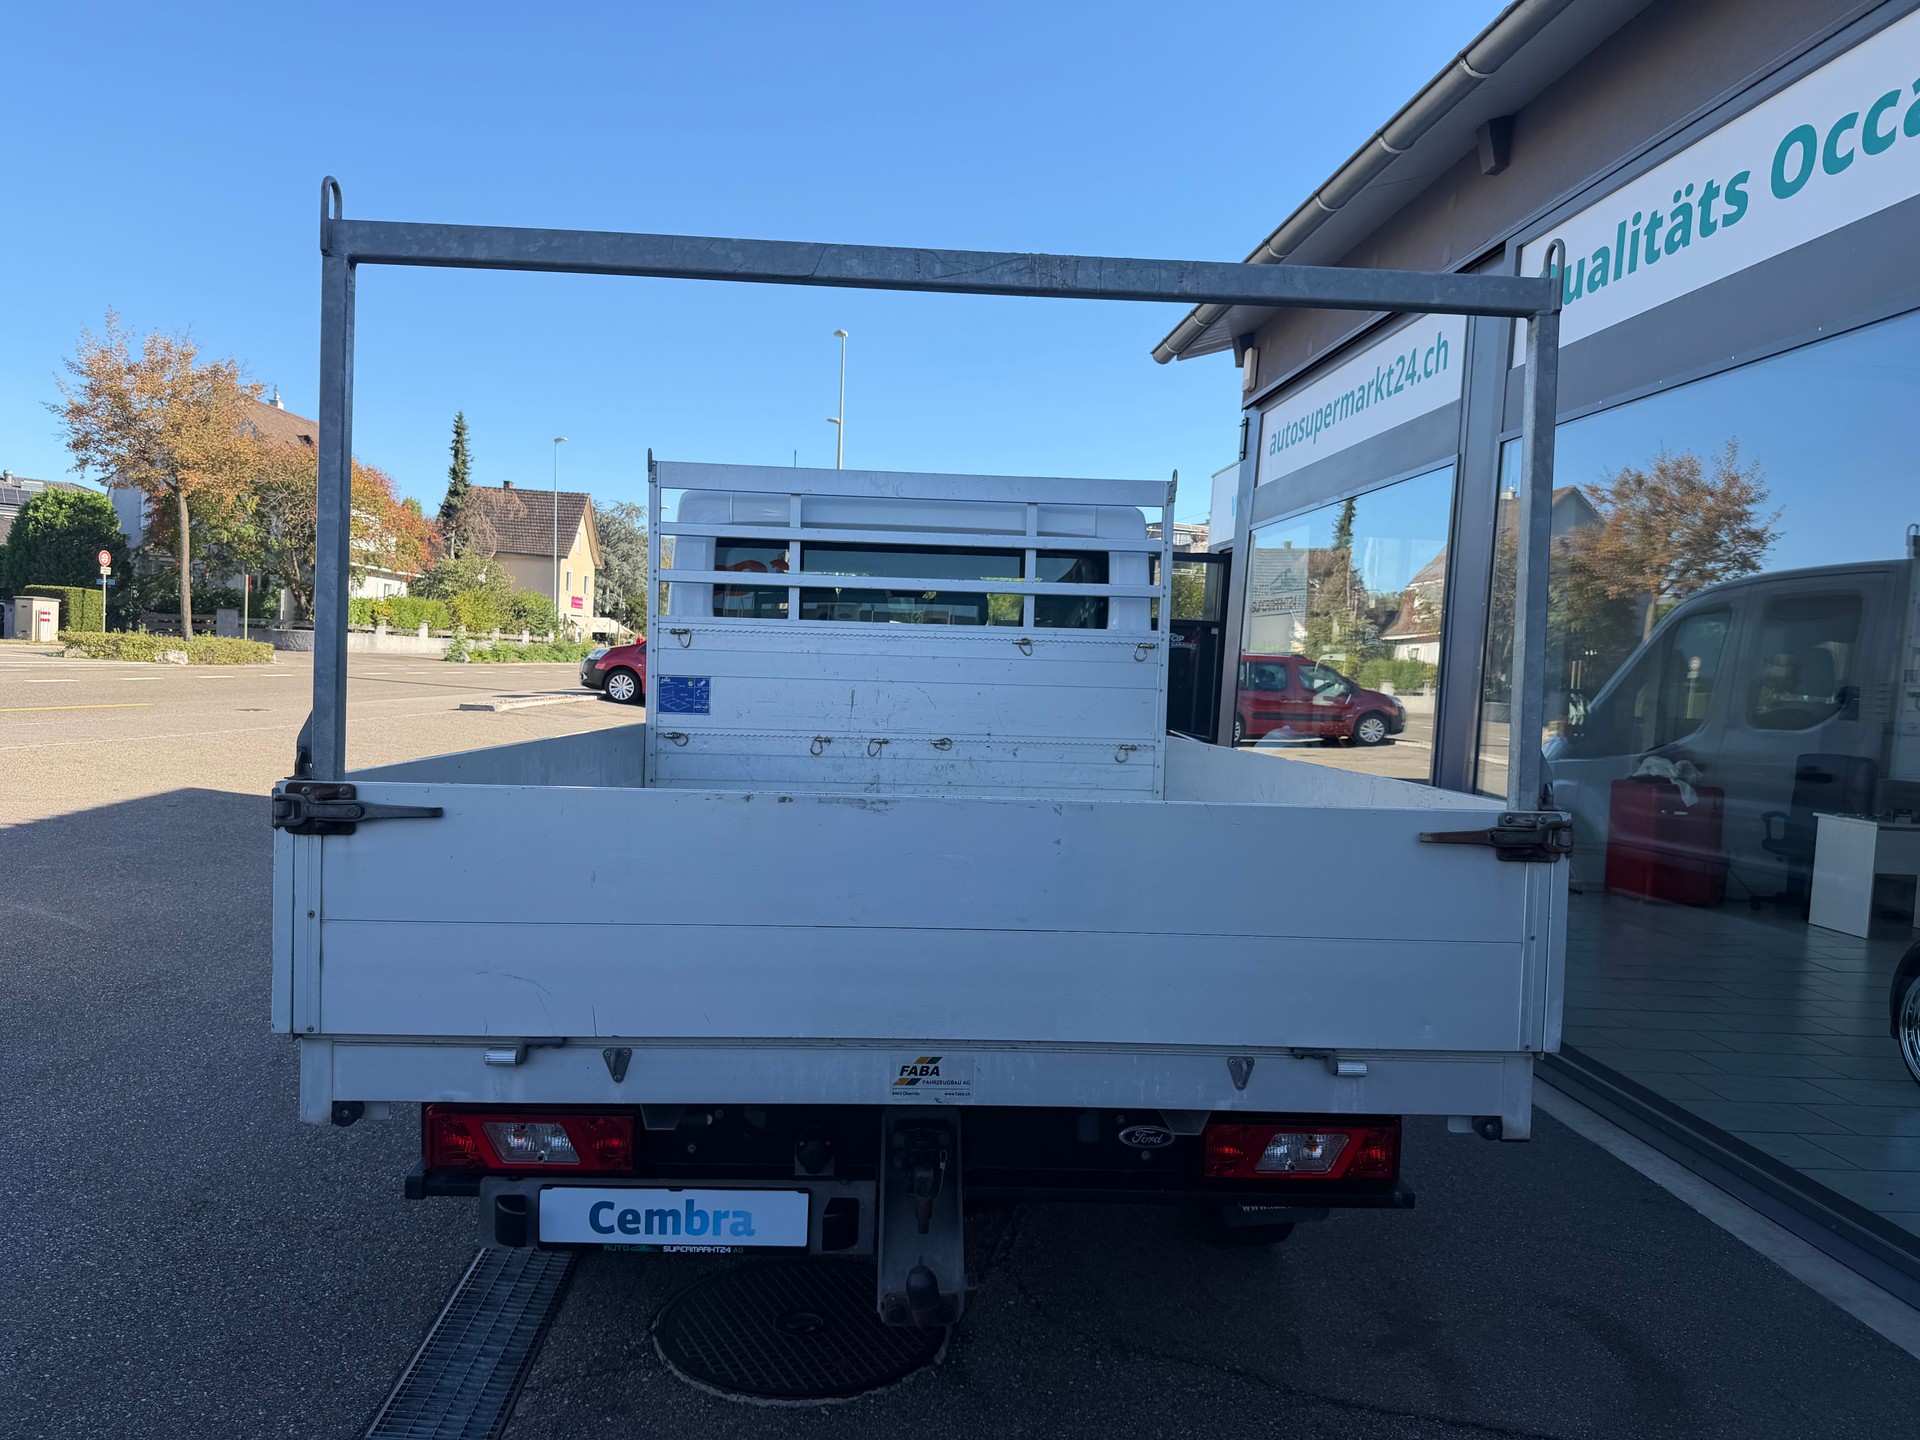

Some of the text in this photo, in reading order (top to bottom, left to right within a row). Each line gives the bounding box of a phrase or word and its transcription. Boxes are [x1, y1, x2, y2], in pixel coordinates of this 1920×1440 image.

[1541, 171, 1751, 305] ualitäts
[1269, 331, 1449, 457] autosupermarkt24.ch
[899, 1065, 940, 1077] FABA
[1131, 1129, 1164, 1144] Ford
[588, 1199, 756, 1237] Cembra
[603, 1244, 630, 1252] AUTO
[662, 1245, 732, 1253] SUPERMARKT24
